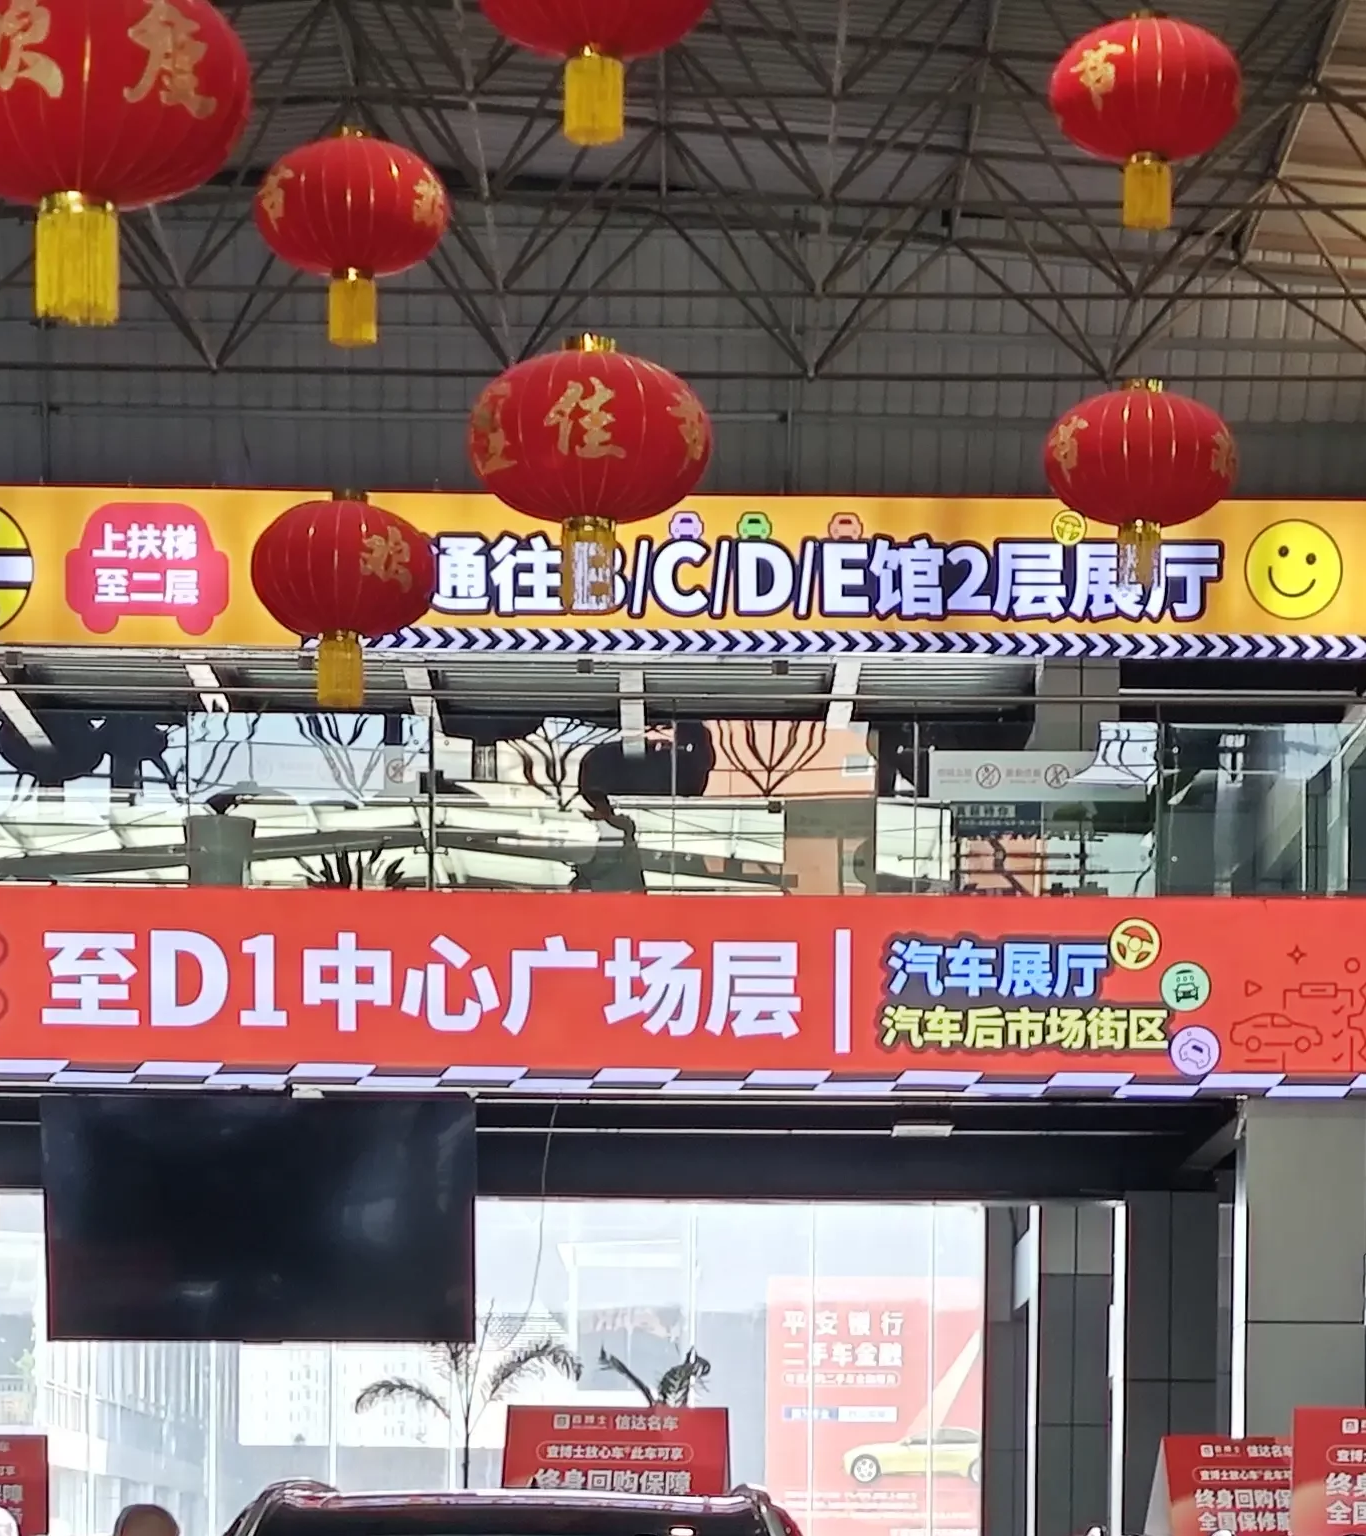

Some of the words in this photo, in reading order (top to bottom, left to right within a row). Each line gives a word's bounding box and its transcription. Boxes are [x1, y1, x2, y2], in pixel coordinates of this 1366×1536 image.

[91, 521, 198, 561] 上扶梯
[92, 567, 201, 607] 至二层
[40, 928, 802, 1039] 至D1中心广场层
[887, 939, 1109, 999] 汽车展厅
[881, 1005, 1170, 1052] 汽车后市场街区
[614, 1414, 679, 1431] 信达名车
